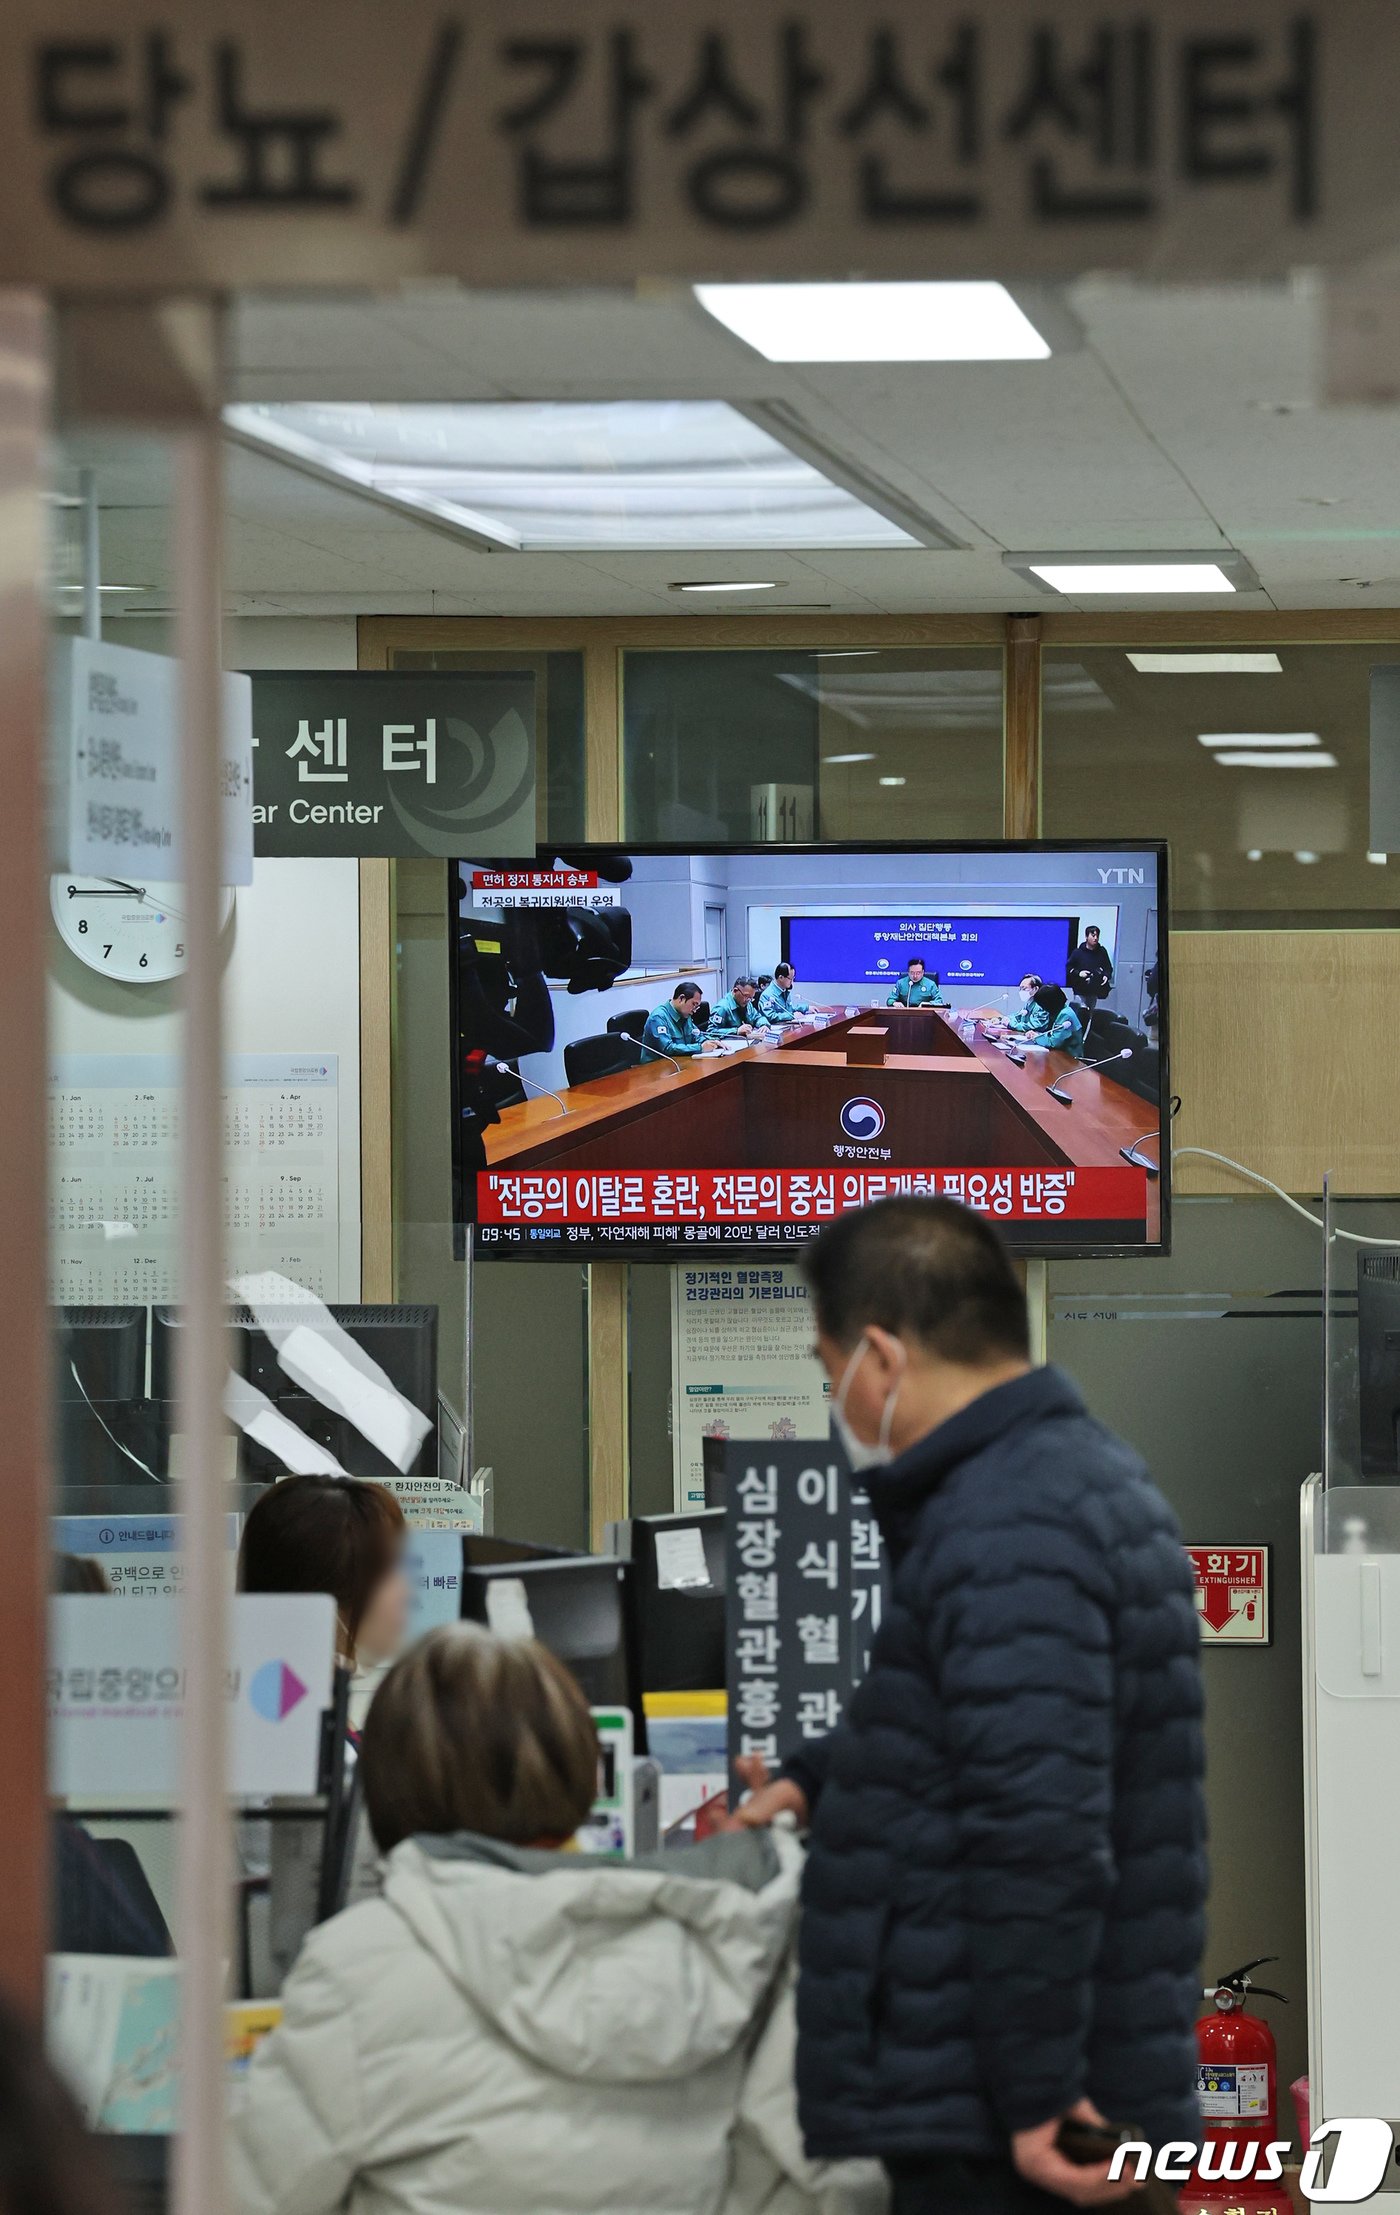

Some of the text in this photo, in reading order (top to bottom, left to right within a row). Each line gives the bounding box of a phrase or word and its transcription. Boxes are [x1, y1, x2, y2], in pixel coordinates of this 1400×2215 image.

[251, 717, 438, 785] 센터
[289, 799, 383, 824] Center
[482, 873, 589, 886] 면허 정지 통지서 송부
[1097, 867, 1144, 884] YTN
[78, 920, 88, 934] 8
[102, 945, 113, 959] 7
[138, 953, 148, 968] 6
[832, 1144, 892, 1160] 행정안전부
[575, 1174, 646, 1217] 이탈로
[651, 1174, 706, 1220] 혼란,
[711, 1174, 782, 1217] 전문의
[787, 1173, 835, 1216] 중심
[942, 1172, 1013, 1216] 필요성
[482, 1228, 522, 1241] 09:45
[529, 1228, 562, 1240] 통일외교
[566, 1227, 594, 1242] 정부,
[684, 1226, 721, 1240] 몽골에
[724, 1226, 753, 1240] 20만
[756, 1225, 780, 1240] 달러
[783, 1225, 821, 1240] 인도적
[685, 1270, 784, 1284] 정기적인 혈압측정
[686, 1288, 744, 1300] 건강관리의
[395, 1482, 440, 1492] 환자안전의
[118, 1530, 176, 1542] 안내드립니다
[110, 1566, 166, 1582] 공백으로
[433, 1576, 458, 1590] 빠른
[735, 1465, 781, 1769] 심장혈관흉부
[46, 1667, 241, 1702] 립중앙의
